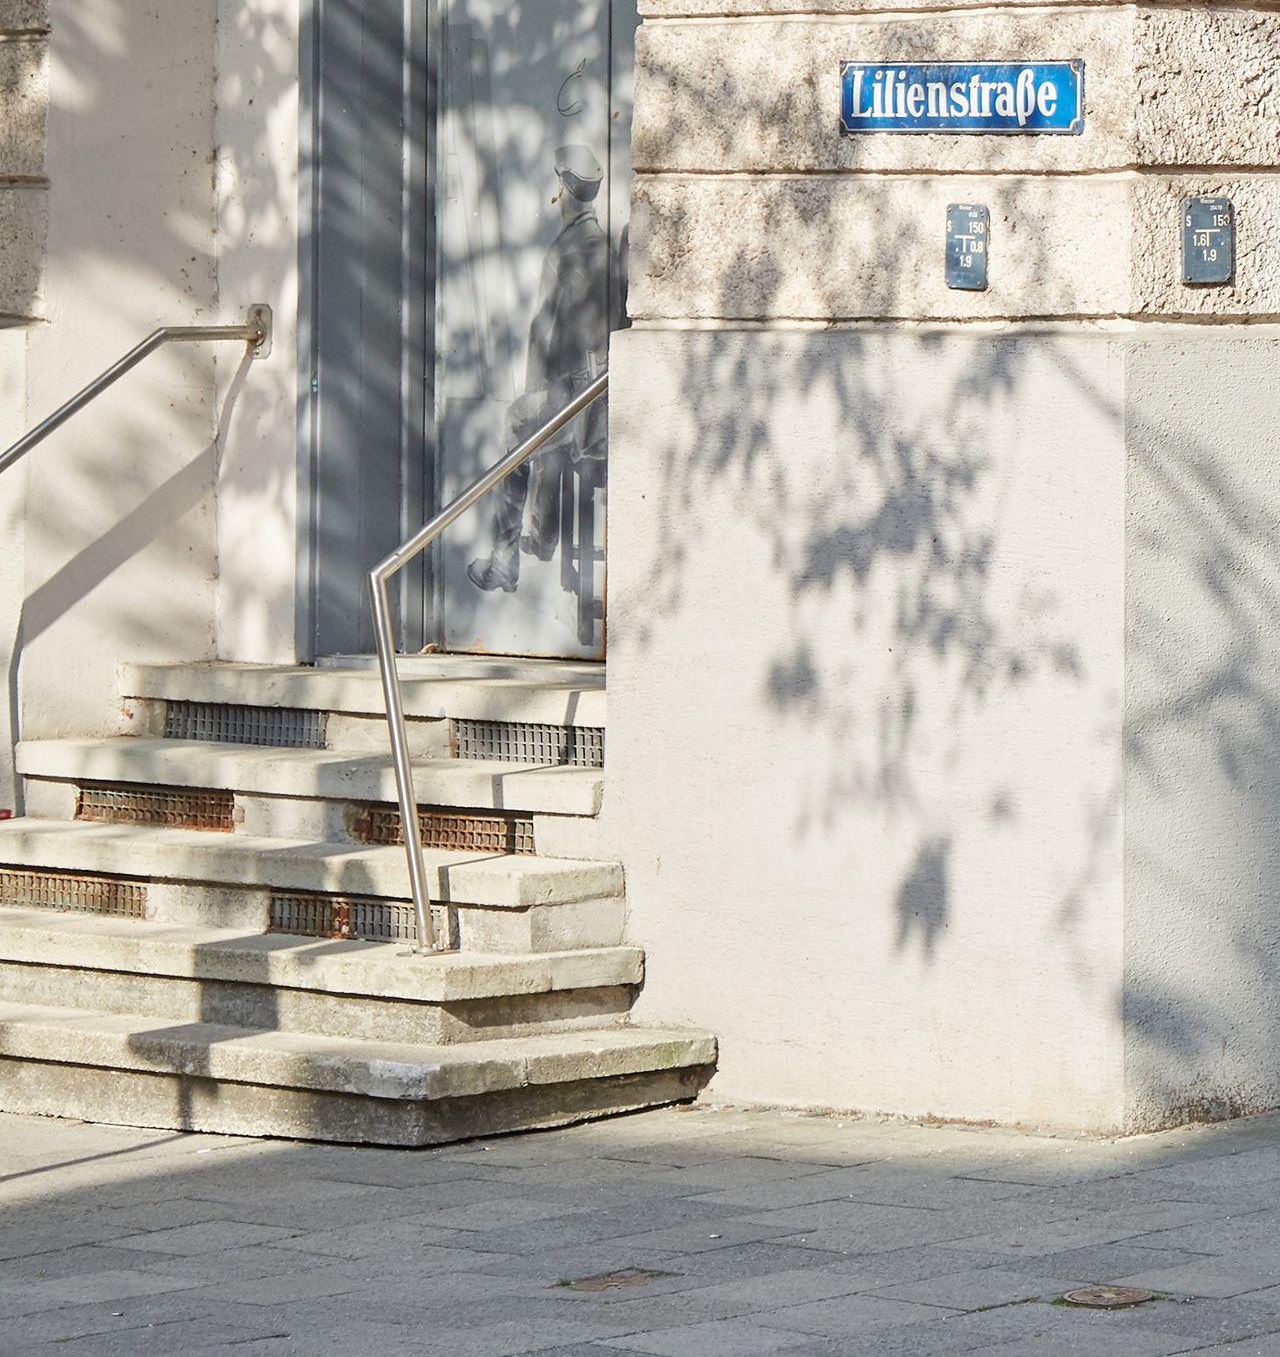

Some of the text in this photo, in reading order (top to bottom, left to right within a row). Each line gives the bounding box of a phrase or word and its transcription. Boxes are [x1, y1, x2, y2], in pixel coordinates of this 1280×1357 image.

[851, 68, 1058, 127] Lilienstraße
[968, 221, 984, 234] 150
[1185, 214, 1231, 228] S 150
